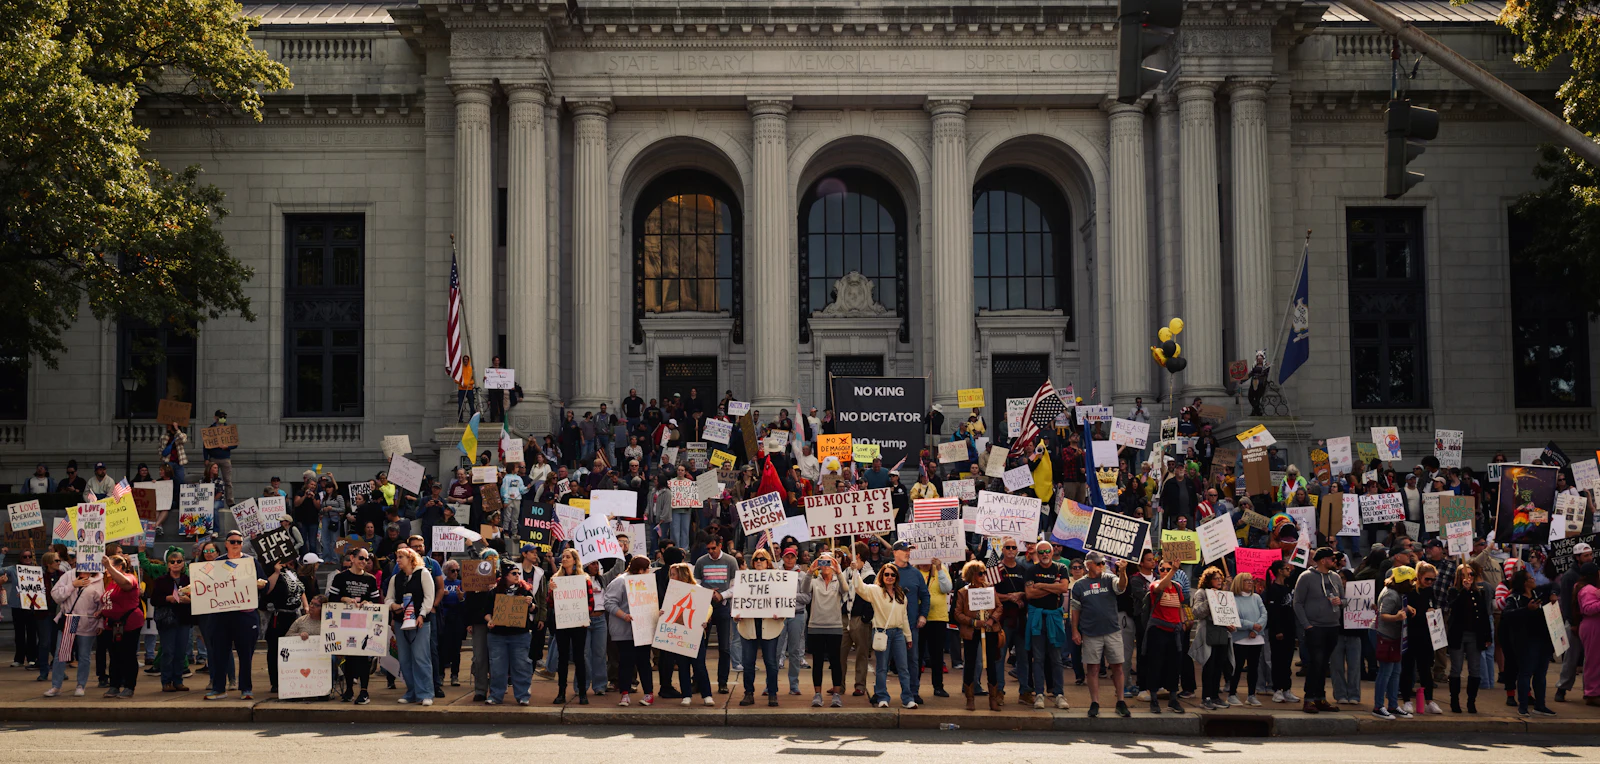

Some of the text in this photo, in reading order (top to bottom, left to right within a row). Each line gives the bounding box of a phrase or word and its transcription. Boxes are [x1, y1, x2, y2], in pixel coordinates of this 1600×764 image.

[608, 55, 746, 71] STATE LIBRARY
[789, 54, 932, 70] MEMORIAL HALL
[966, 54, 1111, 70] SUPREME COURT
[854, 386, 904, 396] NO KING
[840, 412, 921, 422] NO DICTATOR
[202, 427, 234, 436] RELEASE
[1116, 421, 1146, 434] RELEASE
[204, 438, 219, 446] THE
[872, 438, 906, 449] trump
[741, 492, 779, 512] FREEDOM
[806, 489, 888, 508] DEMOCRACY
[984, 494, 1038, 508] IMMIGRANTS
[1450, 497, 1466, 507] NO
[10, 502, 38, 514] I LOVE
[85, 504, 100, 513] LOVE
[244, 506, 256, 515] WE
[532, 506, 544, 515] NO
[752, 503, 773, 517] NOT
[1000, 508, 1036, 519] AMERICA
[1442, 506, 1474, 519] KINGS
[11, 511, 40, 521] AMERICAN
[743, 510, 785, 531] FASCISM
[13, 520, 41, 529] DEMOCRACY
[524, 518, 550, 529] KINGS
[810, 519, 891, 537] IN SILENCE
[983, 518, 1025, 532] GREAT
[1101, 514, 1140, 533] VETERANS
[530, 531, 543, 540] NO
[936, 527, 959, 535] DECEIT
[1097, 524, 1137, 544] AGAINST
[1448, 531, 1471, 539] CRUSHED
[258, 530, 290, 551] FUCK
[1579, 534, 1596, 544] NOT
[79, 545, 104, 553] FIGHTING
[580, 544, 595, 556] La
[1095, 536, 1134, 557] TRUMP
[1163, 543, 1193, 552] WORKERS
[261, 542, 293, 564] I.C.E.
[740, 572, 788, 584] RELEASE
[194, 576, 237, 597] Deport
[749, 584, 769, 595] THE
[1354, 582, 1371, 596] NO
[210, 586, 251, 609] Donald!
[554, 589, 586, 600] REVOLUTION
[734, 598, 796, 609] EPSTEIN FILES
[557, 613, 588, 623] TELEVISED
[660, 624, 677, 633] Elect
[325, 632, 335, 641] NO
[324, 642, 342, 653] KING
[677, 641, 698, 650] CIRCUS
